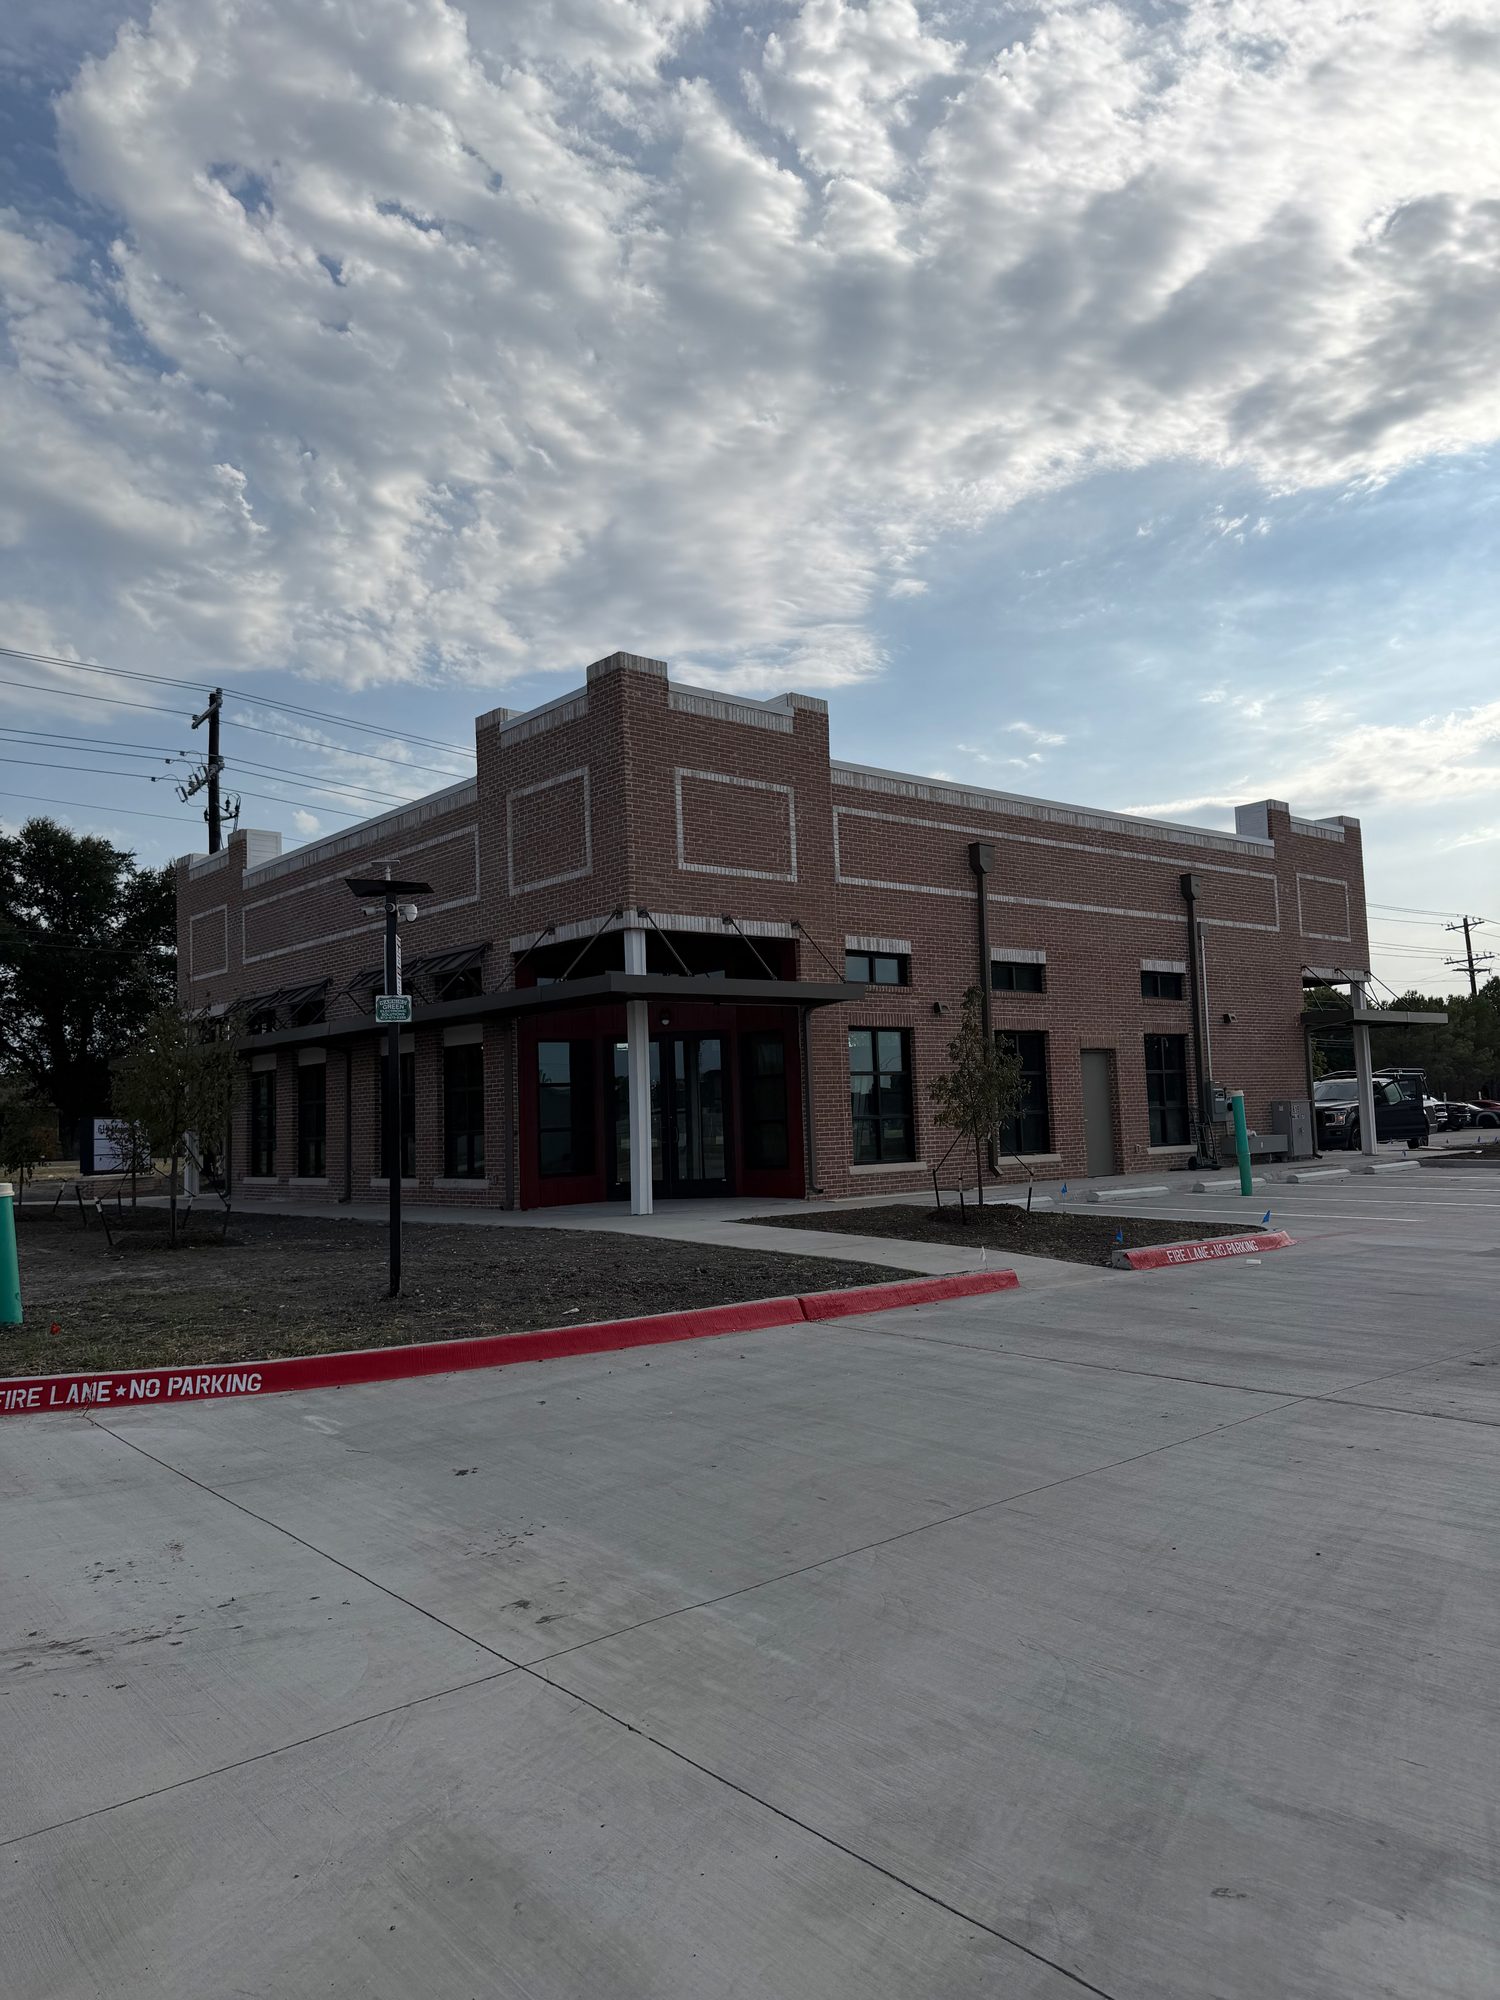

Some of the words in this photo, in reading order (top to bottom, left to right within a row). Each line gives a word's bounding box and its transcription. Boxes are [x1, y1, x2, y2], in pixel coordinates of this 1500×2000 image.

[1167, 1249, 1187, 1263] FIRE
[1187, 1246, 1211, 1261] LANE
[1213, 1243, 1226, 1257] NO
[1226, 1240, 1259, 1255] PARKING
[49, 1380, 113, 1406] LANE
[129, 1378, 161, 1400] NO
[167, 1373, 263, 1397] PARKING
